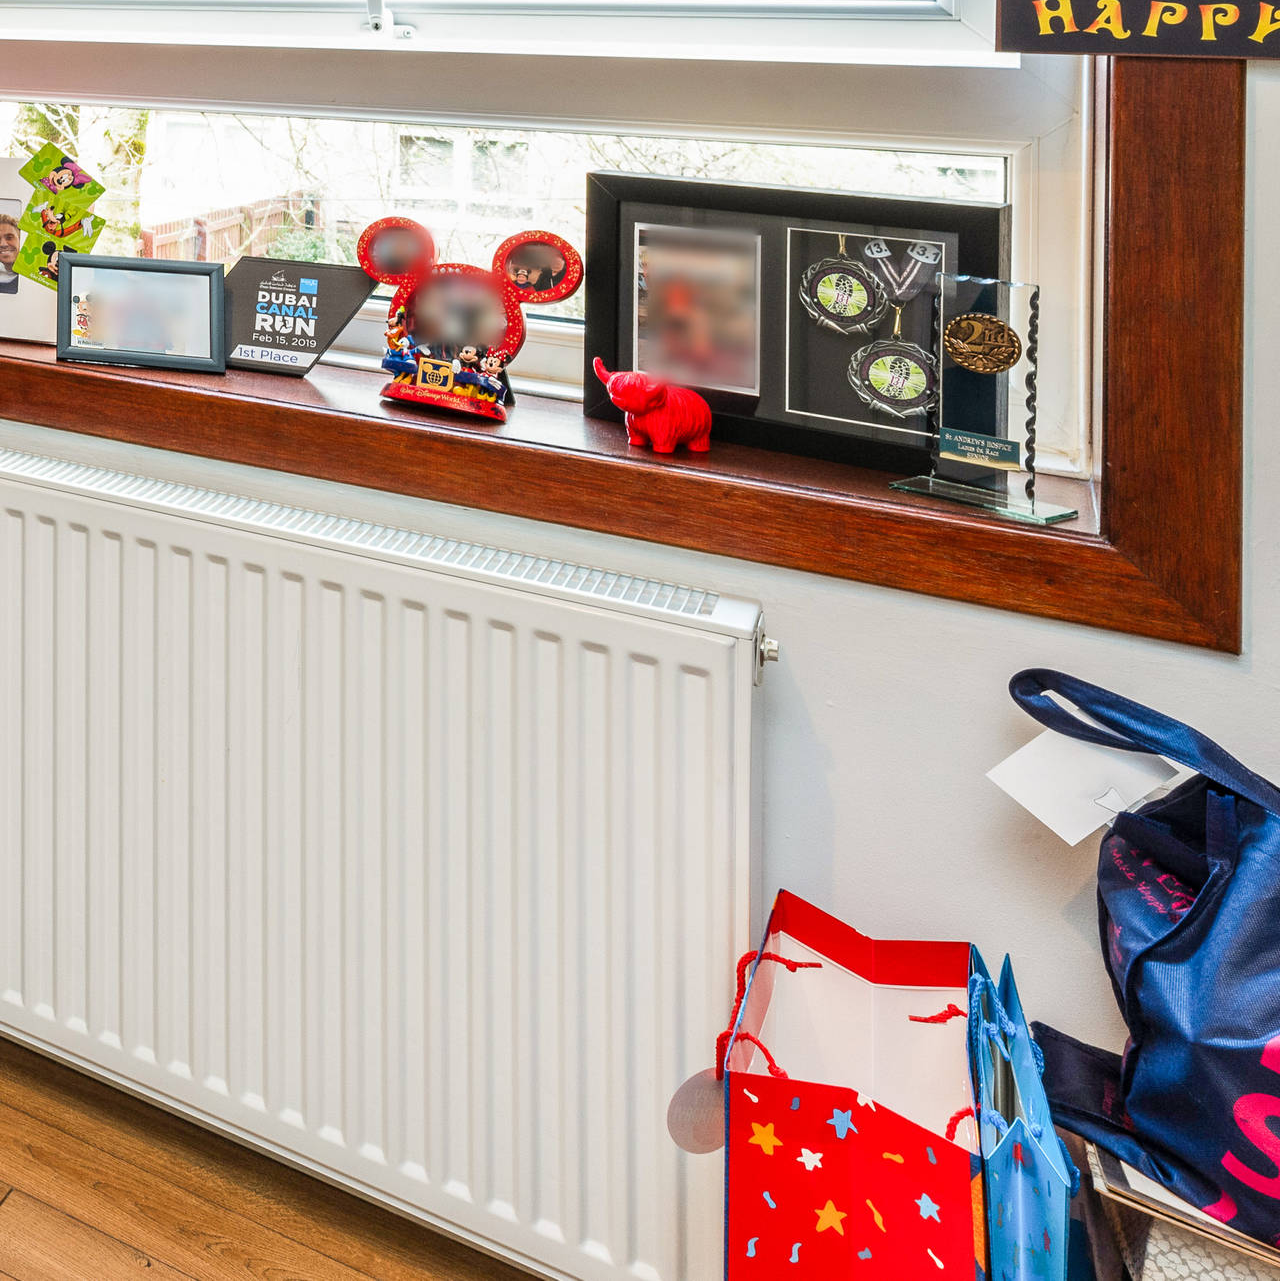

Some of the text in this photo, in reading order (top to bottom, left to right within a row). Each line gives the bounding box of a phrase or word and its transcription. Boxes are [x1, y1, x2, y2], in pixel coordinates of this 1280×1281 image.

[867, 242, 888, 255] 13.
[257, 291, 317, 308] DUBAI
[256, 302, 318, 320] CANAL
[255, 313, 316, 337] RUN
[252, 333, 273, 343] Feb
[291, 338, 317, 348] 2019
[960, 320, 1009, 352] 2nd
[238, 347, 298, 364] 1st Place
